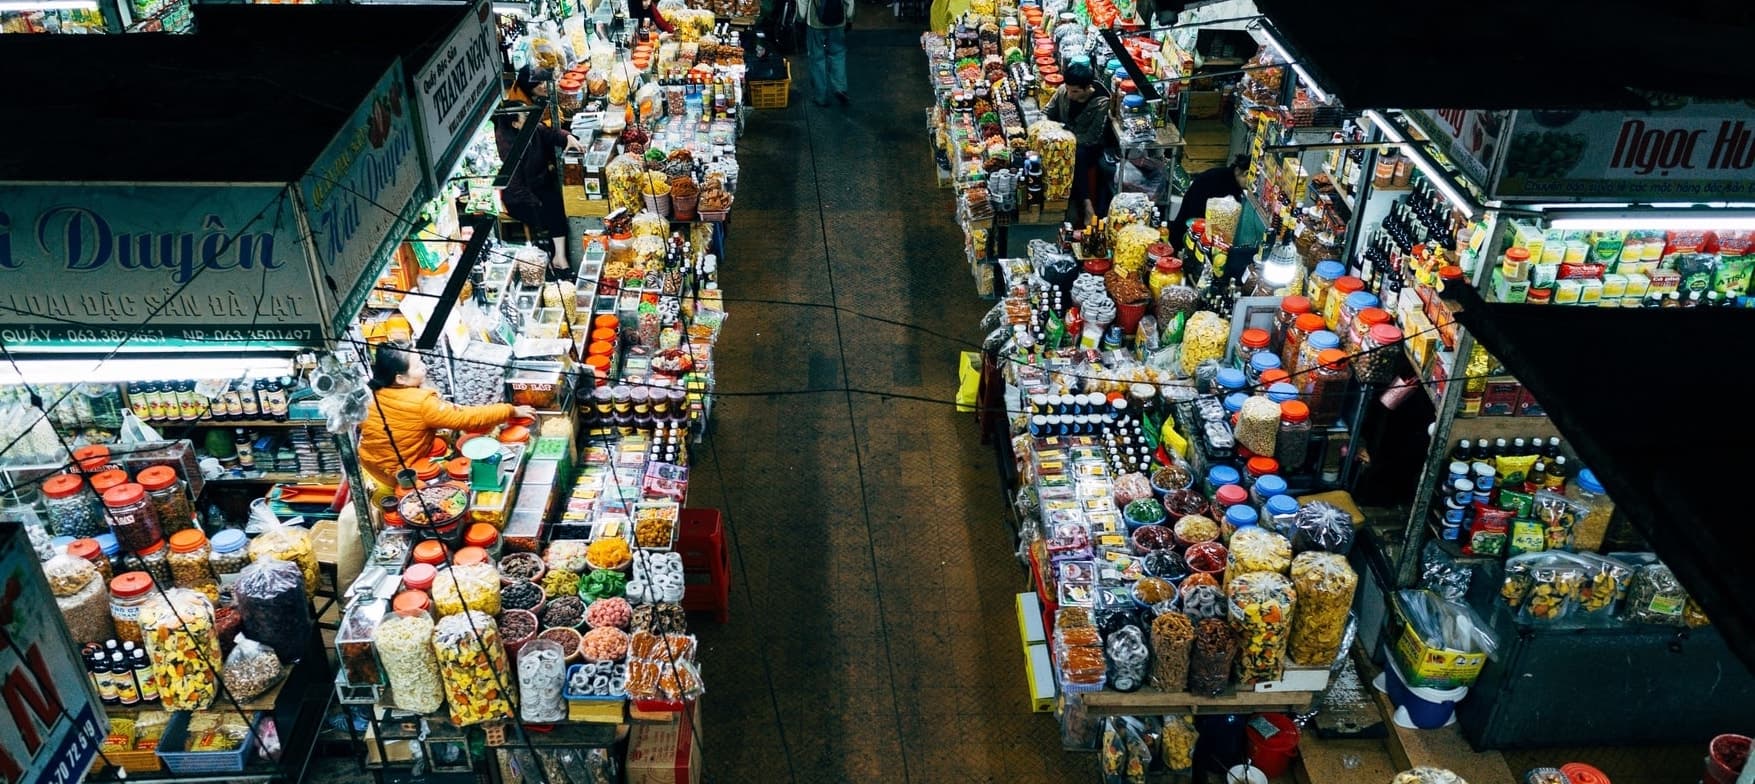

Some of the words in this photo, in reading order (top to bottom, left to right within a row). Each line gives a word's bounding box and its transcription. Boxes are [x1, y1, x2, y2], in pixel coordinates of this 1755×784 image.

[433, 57, 467, 124] THANH
[1610, 120, 1707, 176] Ngọc
[38, 205, 285, 284] Duyên
[80, 290, 137, 321] ĐẶC
[206, 290, 247, 316] ĐÀ
[251, 295, 303, 321] LẠT
